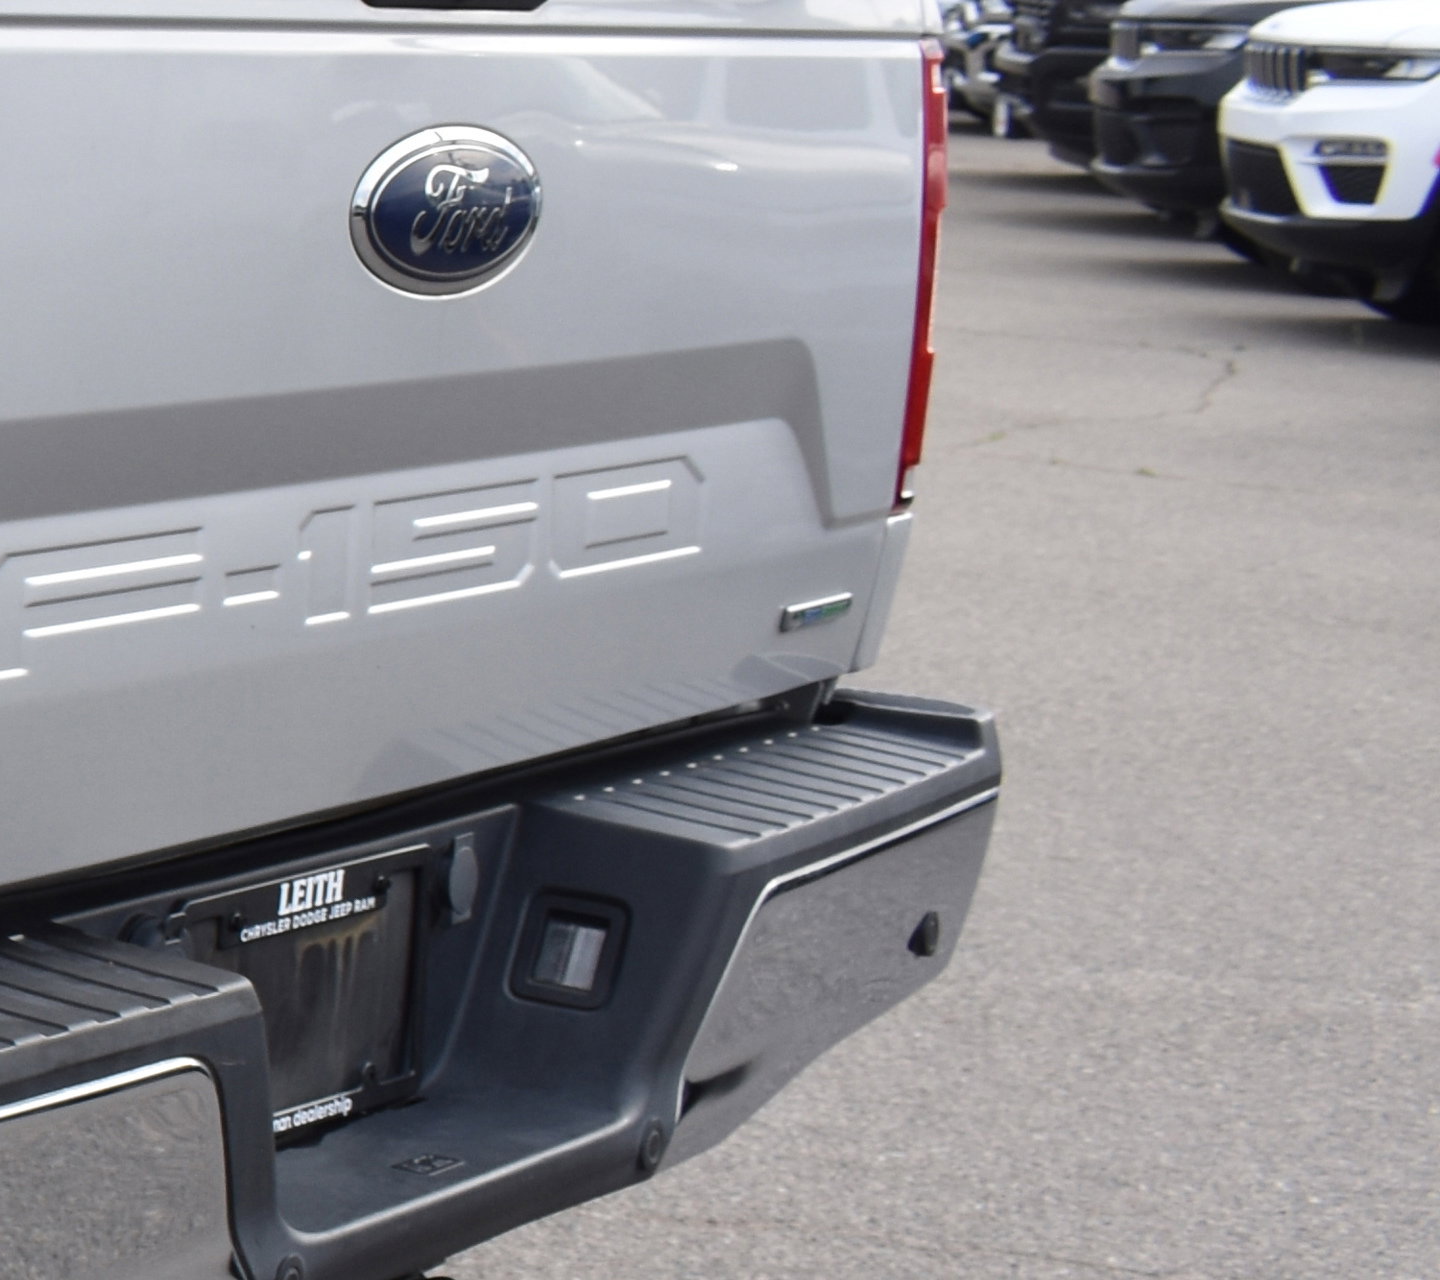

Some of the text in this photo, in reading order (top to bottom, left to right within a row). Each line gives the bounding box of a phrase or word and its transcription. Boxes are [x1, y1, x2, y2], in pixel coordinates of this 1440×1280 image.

[411, 164, 513, 254] Ford
[278, 869, 345, 916] LEITH
[240, 896, 376, 943] CHRYSLER DODGE JEEP RAM
[293, 1096, 353, 1128] dealership
